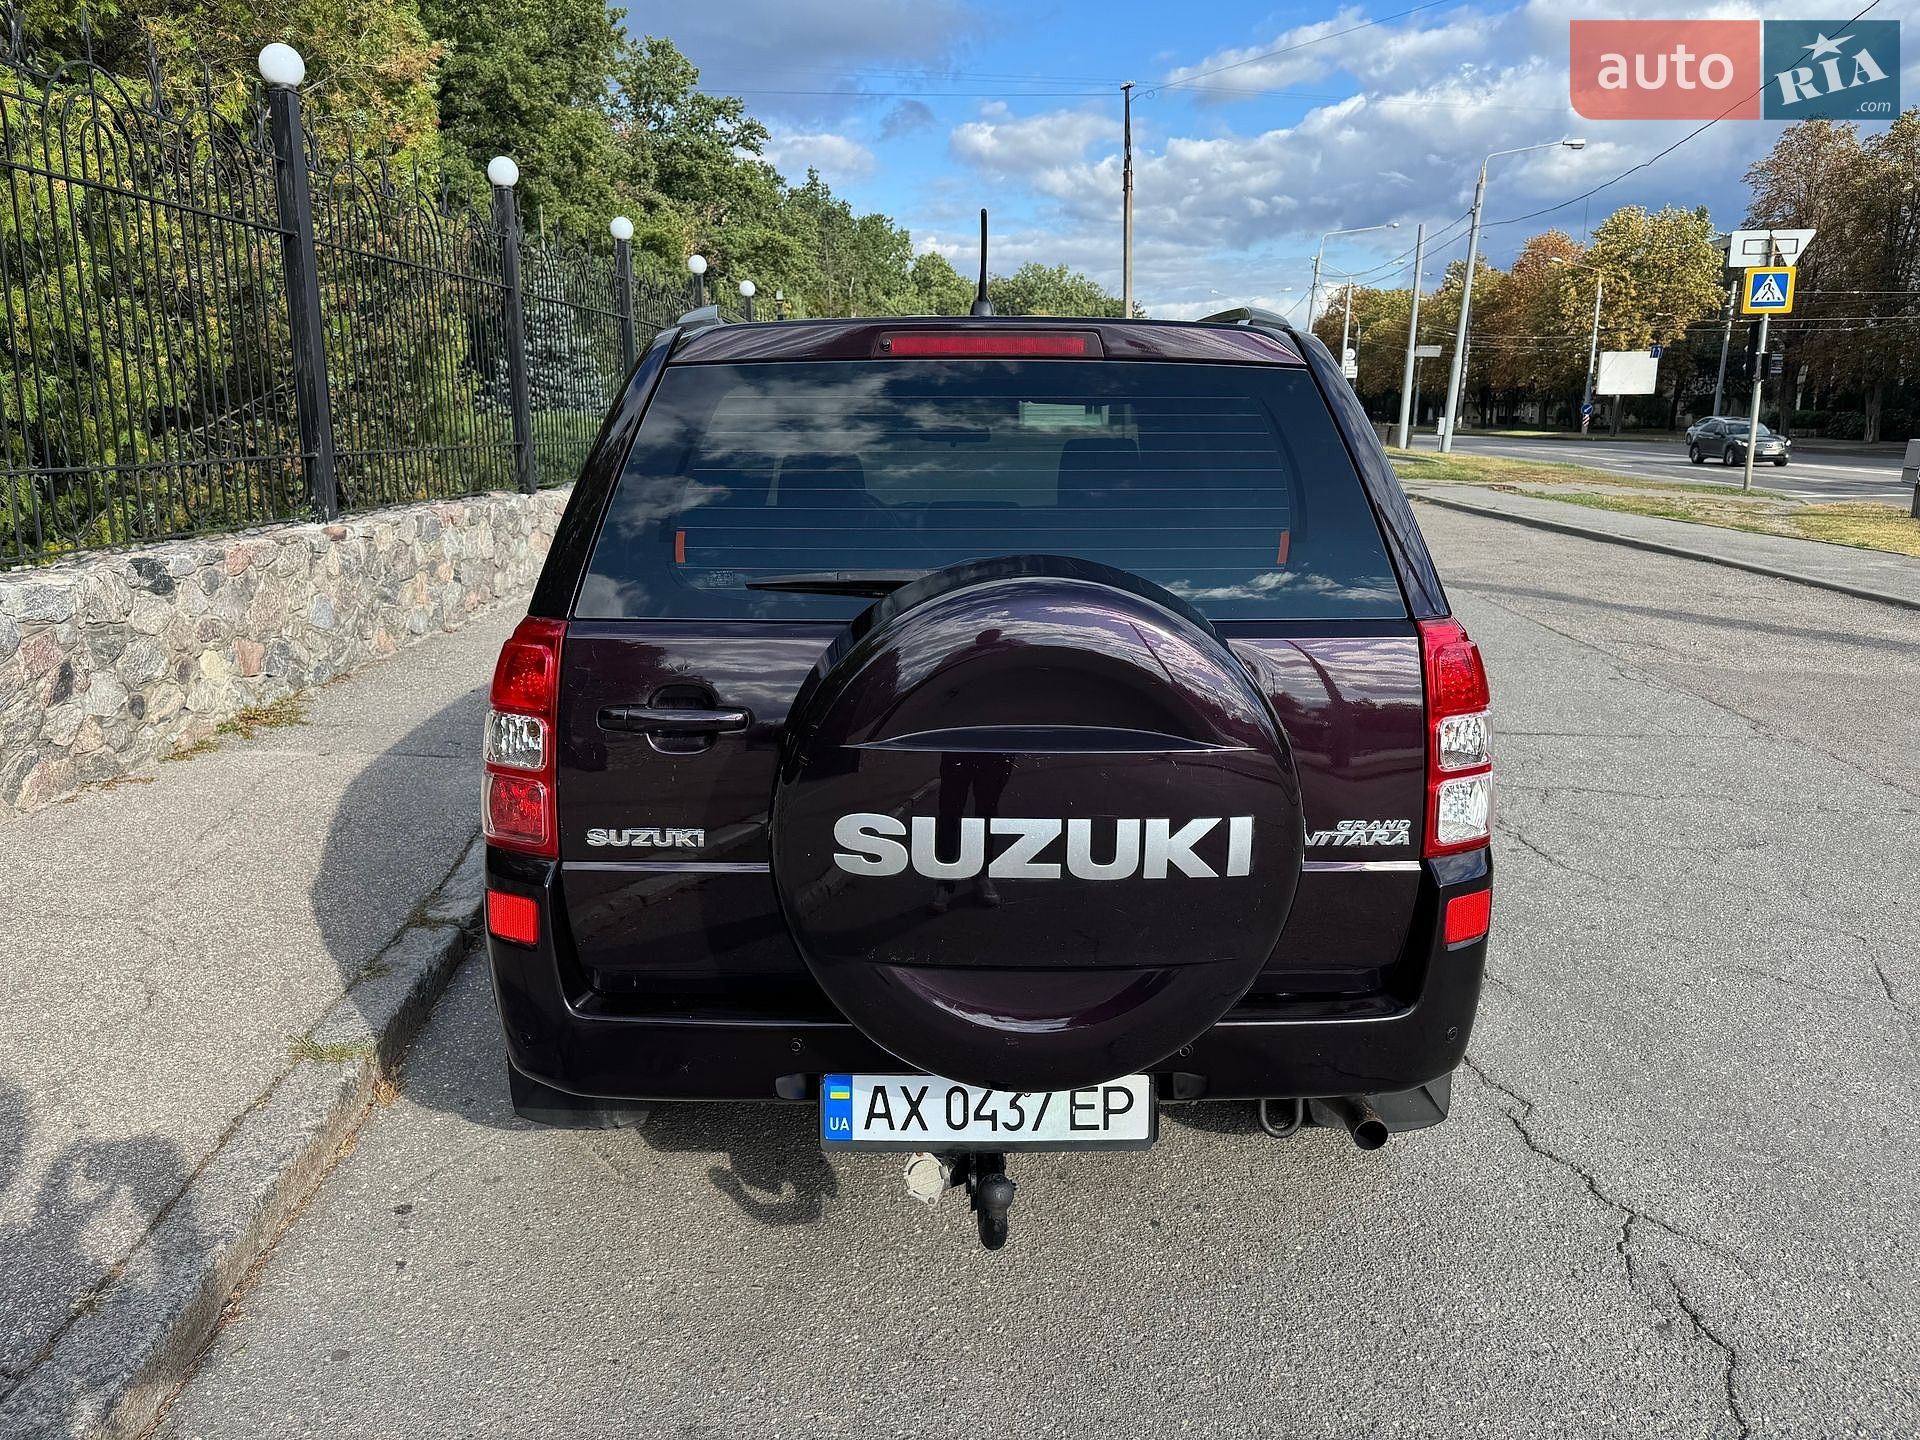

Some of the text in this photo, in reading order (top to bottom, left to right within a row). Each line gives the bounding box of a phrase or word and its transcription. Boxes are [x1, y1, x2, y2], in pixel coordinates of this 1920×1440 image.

[1336, 819, 1412, 831] GRAND
[586, 828, 706, 847] SUZUKI
[833, 812, 1253, 880] SUZUKI
[863, 1085, 929, 1131] AX
[1069, 1085, 1134, 1131] EP
[829, 1116, 850, 1131] UA
